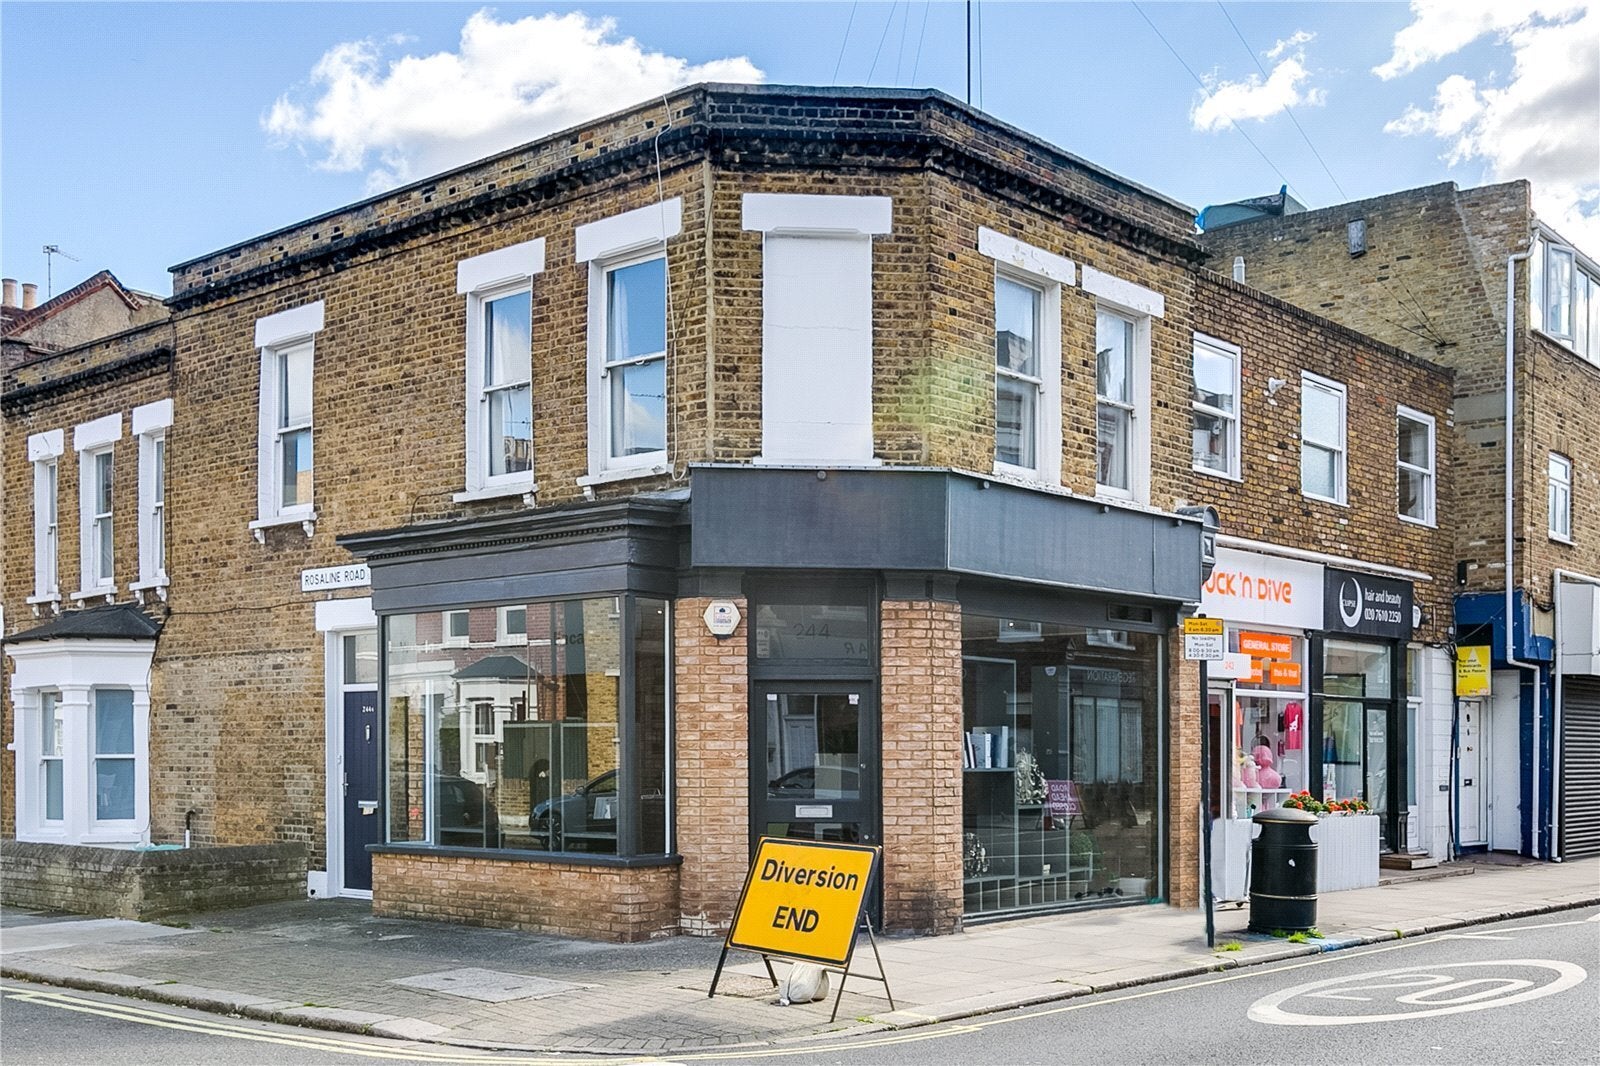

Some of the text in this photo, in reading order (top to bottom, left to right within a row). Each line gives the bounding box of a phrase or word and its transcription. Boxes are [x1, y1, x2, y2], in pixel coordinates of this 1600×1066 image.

[304, 568, 366, 586] ROSALINE ROAD
[1205, 571, 1236, 597] UCK
[1365, 587, 1402, 608] hair and beauty
[1364, 608, 1375, 620] 020
[1375, 609, 1388, 622] 7610
[1388, 610, 1402, 624] 2250
[793, 623, 830, 640] 244
[1243, 639, 1290, 653] GENERAL STORE
[760, 858, 859, 892] Diversion
[772, 905, 820, 933] END
[1302, 974, 1535, 1006] 20
